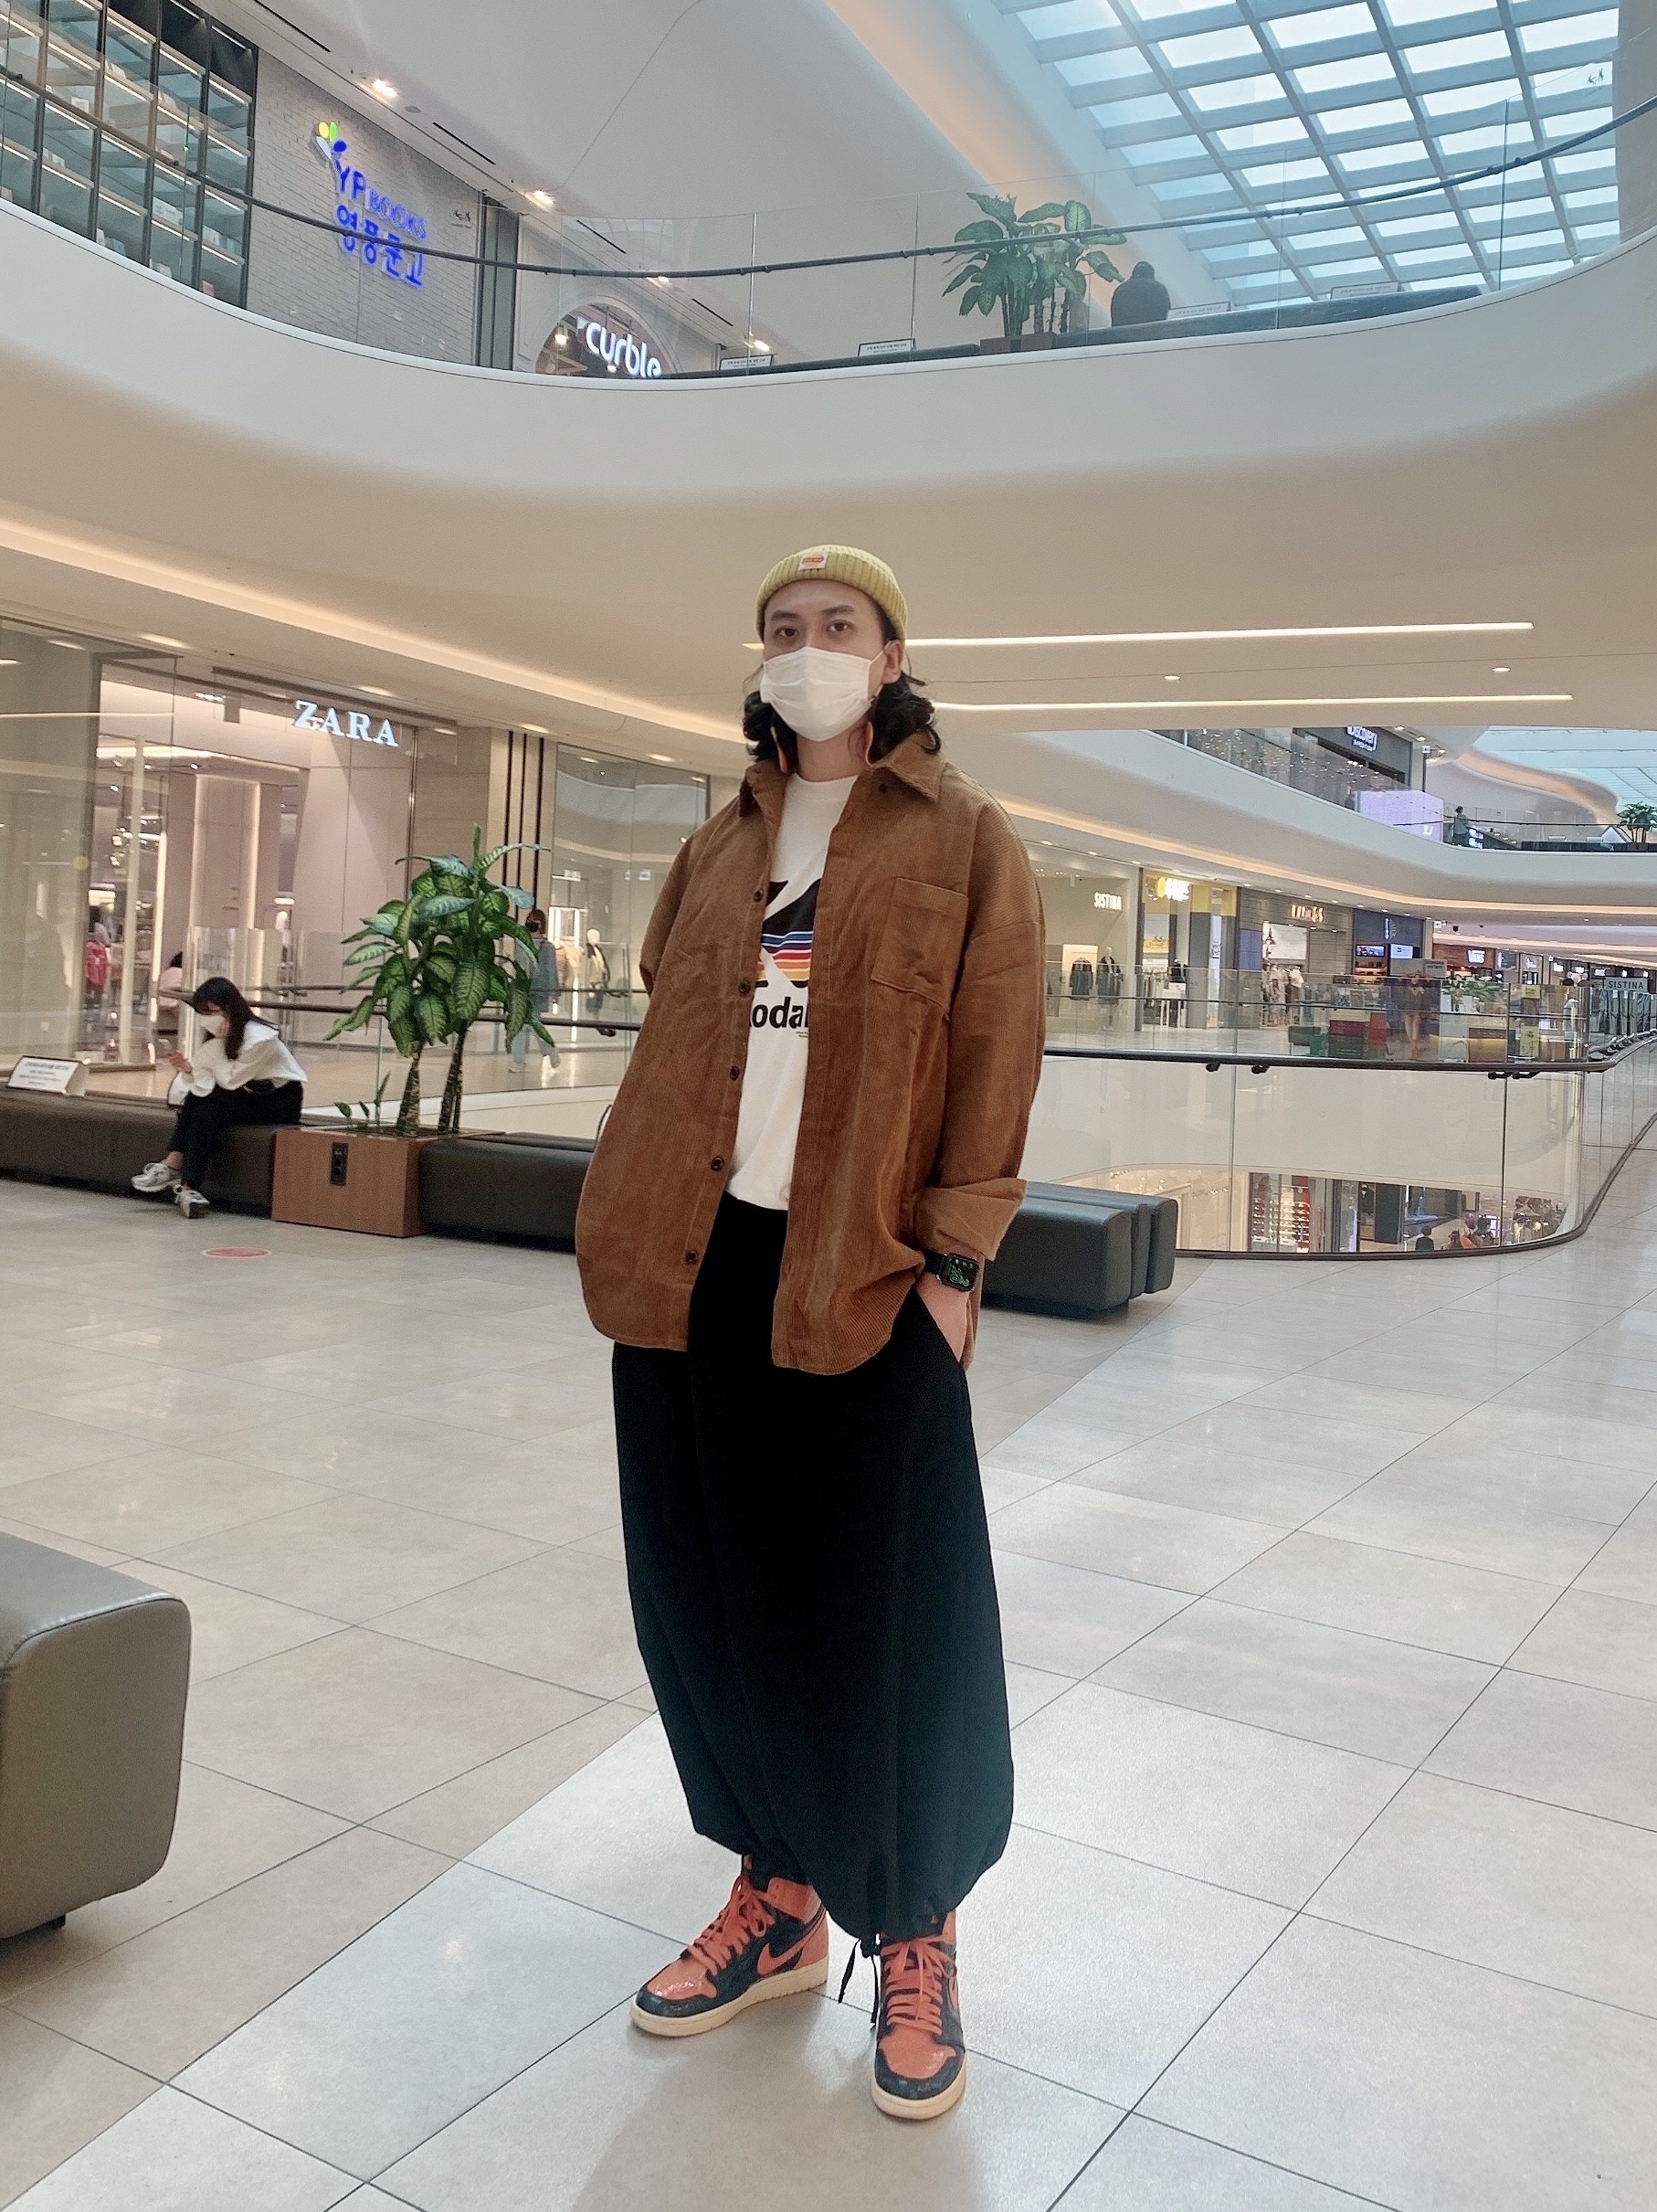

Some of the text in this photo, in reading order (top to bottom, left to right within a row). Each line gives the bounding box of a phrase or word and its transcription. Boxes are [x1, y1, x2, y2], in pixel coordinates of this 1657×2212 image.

[333, 159, 427, 240] YP BOOKS
[336, 204, 424, 288] 영풍문고
[586, 322, 662, 378] curble
[294, 699, 399, 747] ZARA
[1094, 892, 1123, 911] SISTINA
[1608, 980, 1644, 990] SISTINA
[750, 996, 808, 1029] oda
